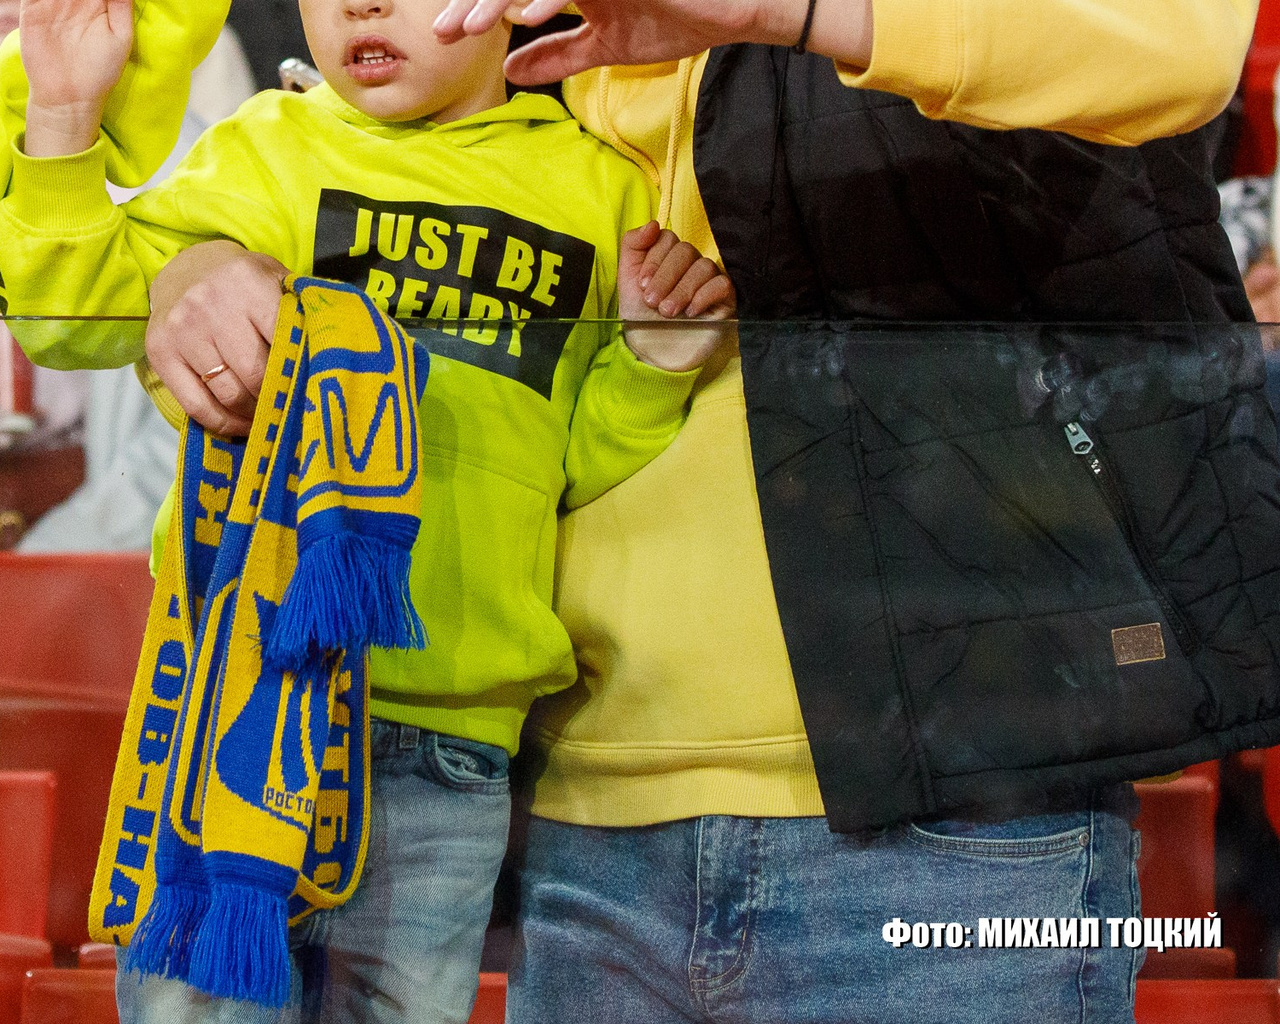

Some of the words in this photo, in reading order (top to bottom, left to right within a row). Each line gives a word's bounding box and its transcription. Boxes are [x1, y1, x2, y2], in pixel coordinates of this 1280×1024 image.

[349, 208, 489, 278] JUST
[496, 235, 563, 307] BE
[365, 268, 532, 357] READY
